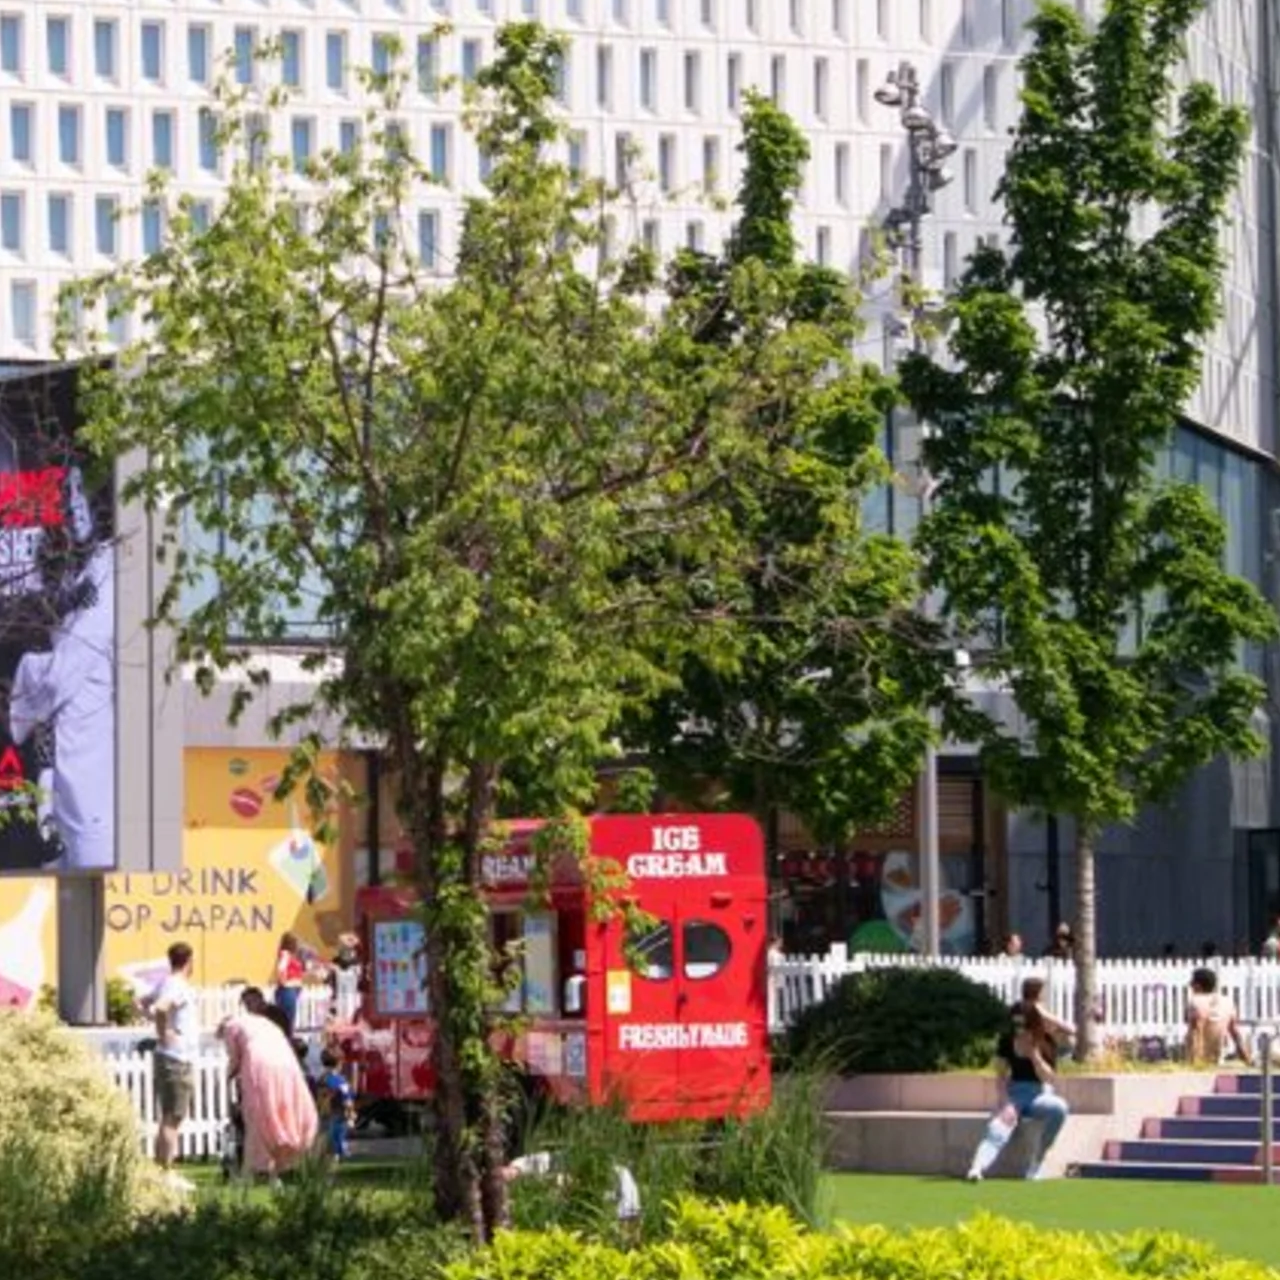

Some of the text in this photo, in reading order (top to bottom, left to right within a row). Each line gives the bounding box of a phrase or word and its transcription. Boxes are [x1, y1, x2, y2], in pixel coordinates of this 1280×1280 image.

[651, 825, 701, 851] ICE
[627, 853, 728, 879] CREAM
[152, 868, 258, 895] DRINK
[161, 903, 274, 932] JAPAN
